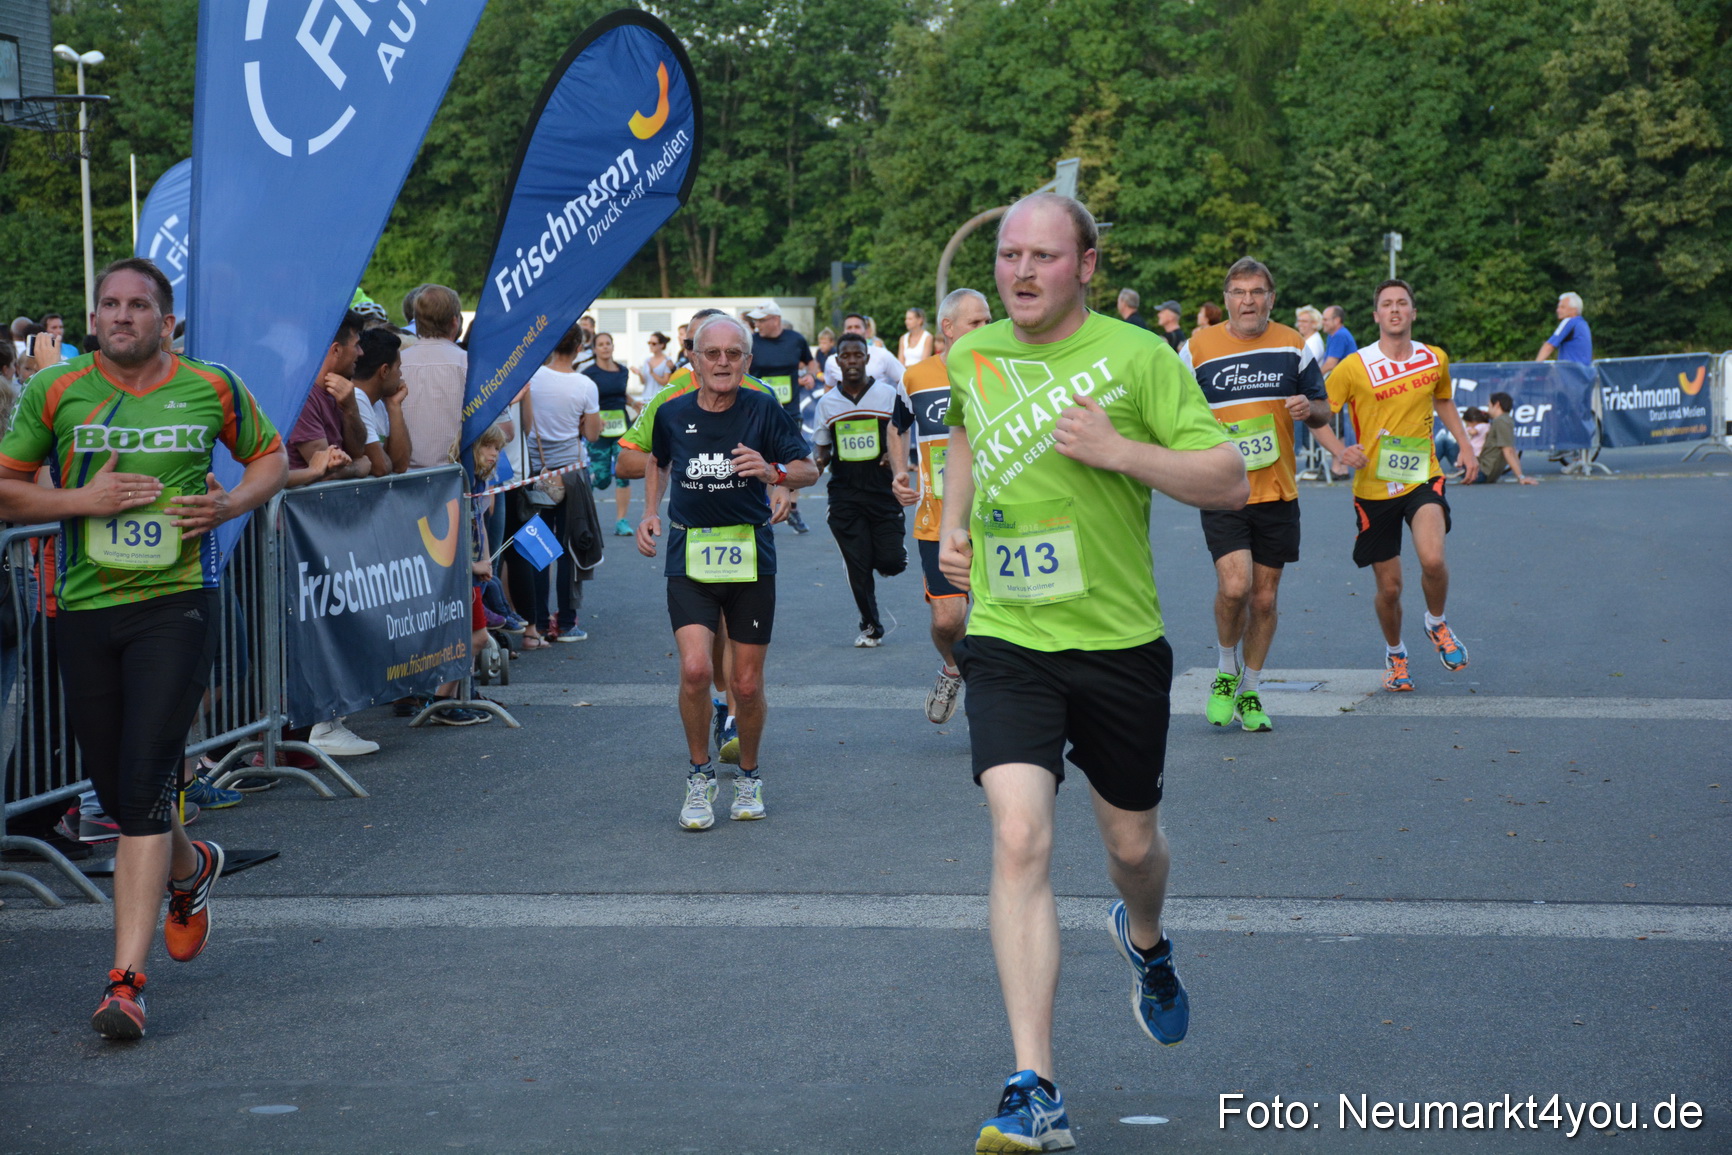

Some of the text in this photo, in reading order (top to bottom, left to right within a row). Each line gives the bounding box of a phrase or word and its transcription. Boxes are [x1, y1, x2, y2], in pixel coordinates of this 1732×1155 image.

[377, 0, 428, 84] AU
[586, 201, 623, 245] Druck
[646, 129, 689, 187] Medien
[494, 148, 638, 312] Frischmann
[1224, 370, 1284, 387] Fischer
[1231, 382, 1280, 392] AUTOMOBILE
[1375, 384, 1409, 402] MAX
[1602, 384, 1681, 411] Frischmann
[74, 424, 208, 452] BOCK
[841, 435, 875, 450] 1666
[1239, 435, 1273, 456] 633
[1000, 461, 1024, 486] UND
[1388, 454, 1420, 471] 892
[707, 480, 734, 493] guad
[105, 518, 162, 547] 139
[103, 550, 131, 559] Wolfgang
[701, 546, 743, 566] 178
[996, 541, 1060, 578] 213
[298, 551, 432, 622] Frischmann
[1007, 582, 1055, 592] Markus Kollmer
[386, 609, 415, 640] Druck
[417, 602, 436, 631] und
